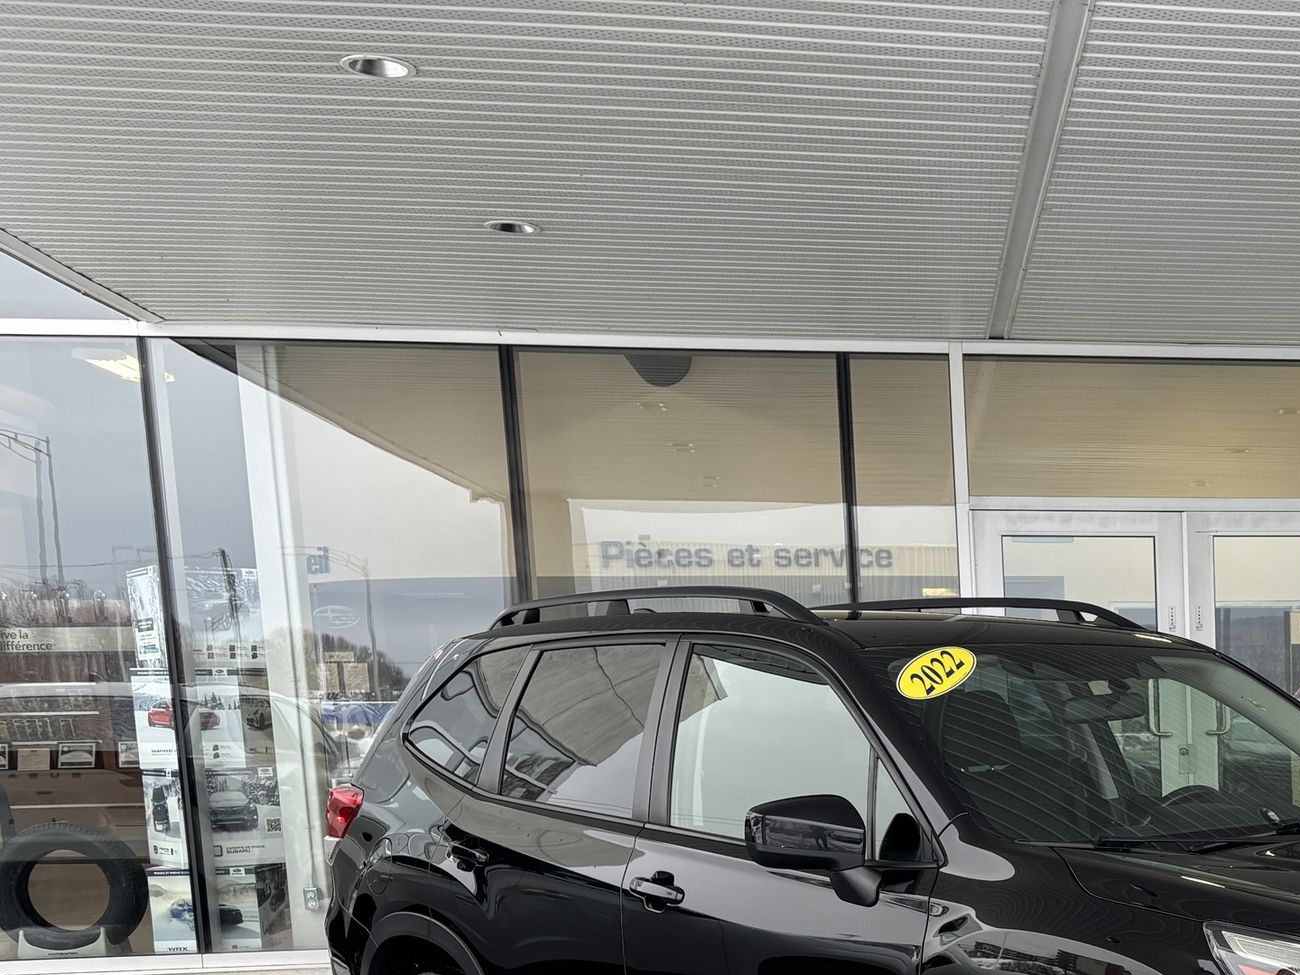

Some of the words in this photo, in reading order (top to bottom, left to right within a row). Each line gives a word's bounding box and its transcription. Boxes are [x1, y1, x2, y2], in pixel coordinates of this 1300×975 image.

[600, 537, 713, 569] Pièces
[727, 544, 761, 569] et
[774, 545, 893, 569] servce
[0, 629, 16, 640] ive
[19, 628, 29, 640] la
[910, 650, 965, 695] 2022
